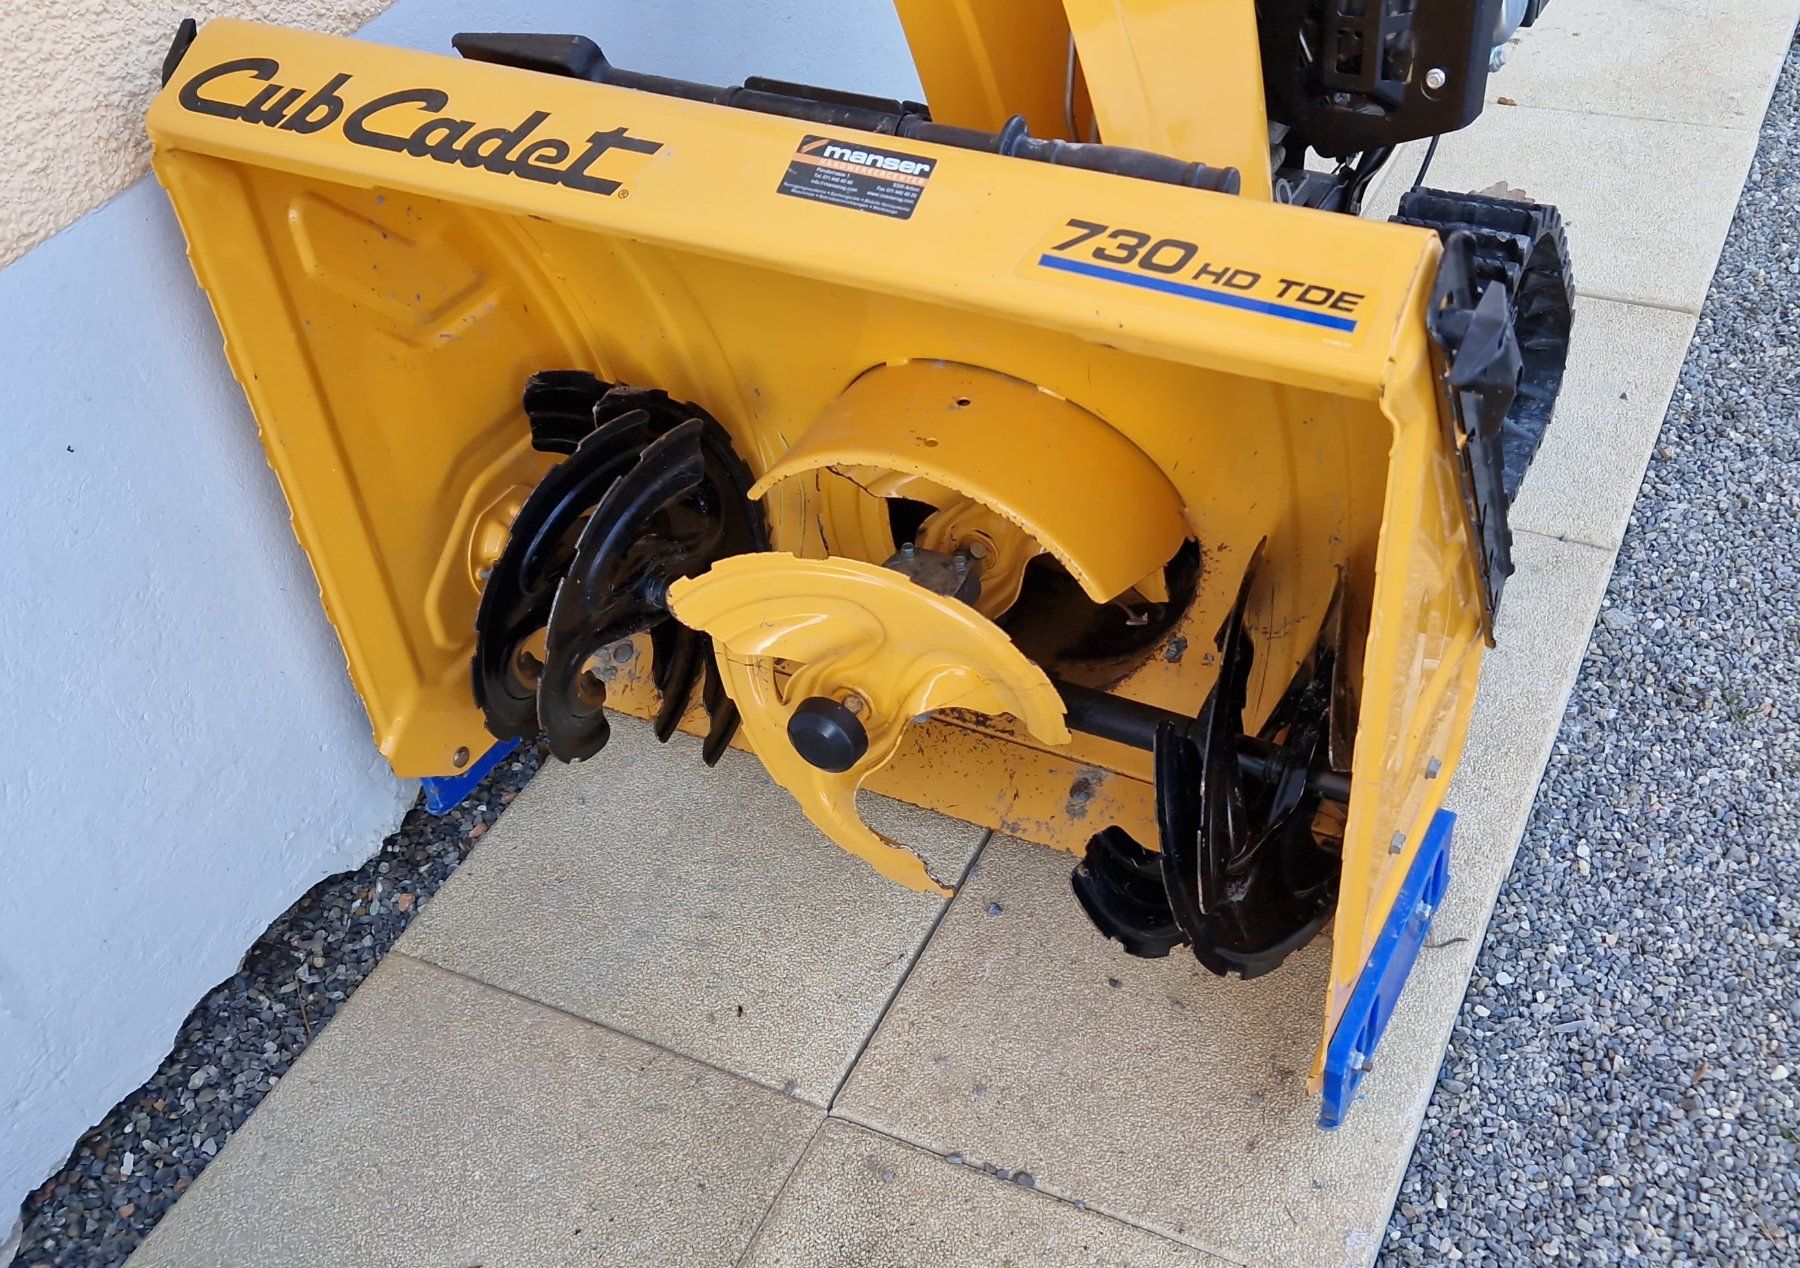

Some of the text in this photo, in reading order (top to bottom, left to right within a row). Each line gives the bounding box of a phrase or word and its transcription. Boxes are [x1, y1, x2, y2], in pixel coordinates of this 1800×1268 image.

[178, 57, 665, 197] Cub Cadet
[823, 145, 931, 175] manser
[1051, 218, 1366, 313] 730 HD TDE
